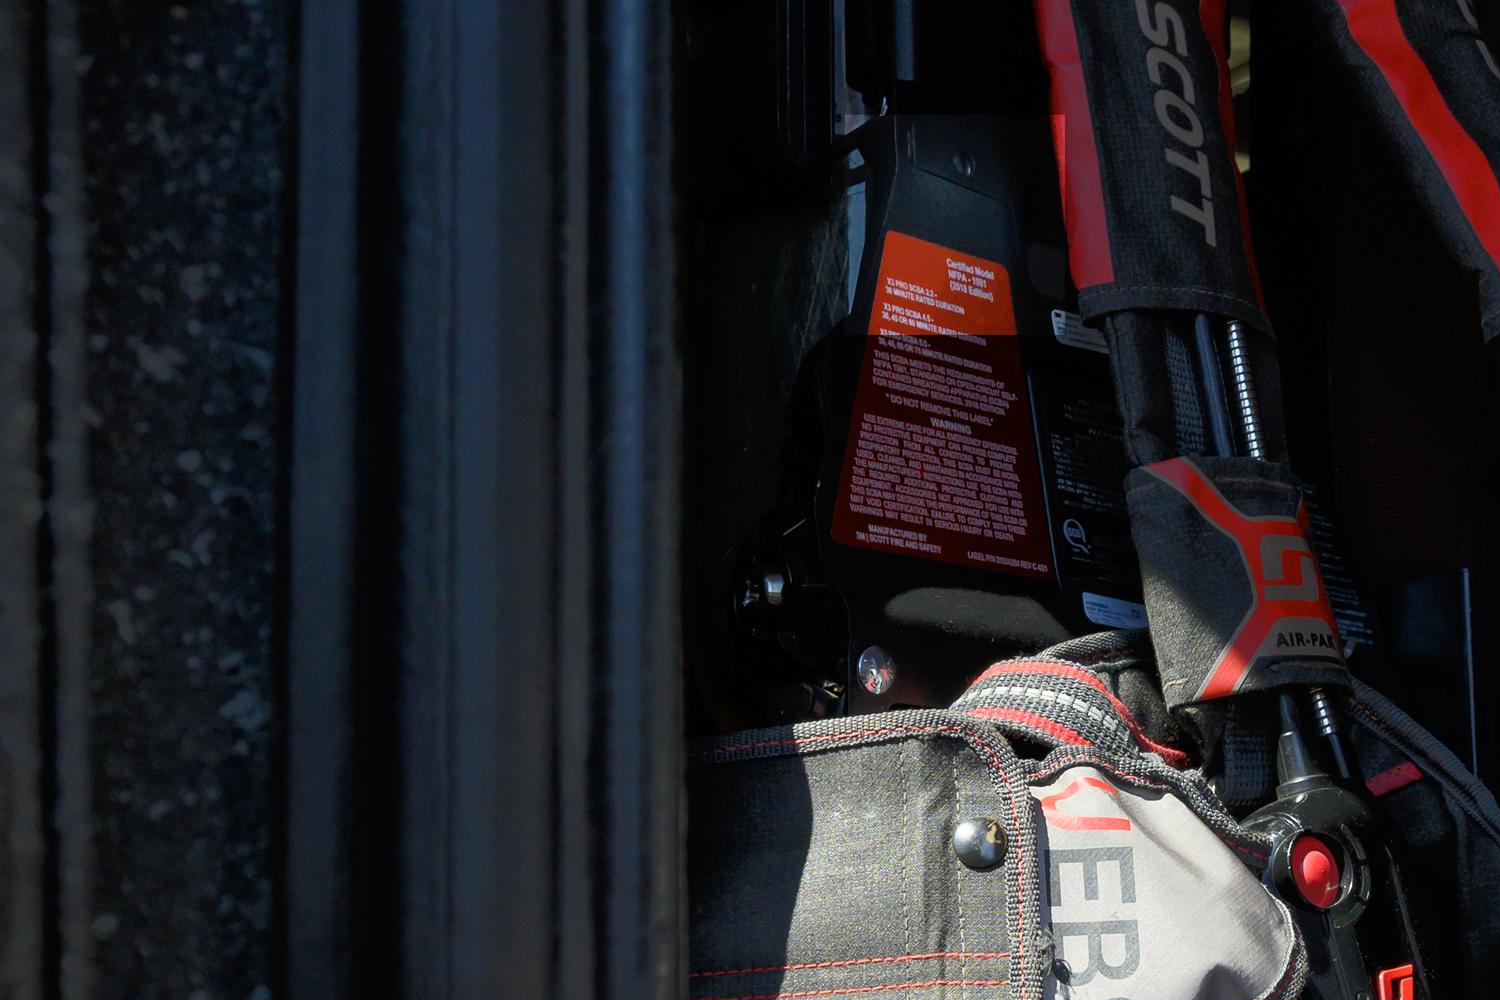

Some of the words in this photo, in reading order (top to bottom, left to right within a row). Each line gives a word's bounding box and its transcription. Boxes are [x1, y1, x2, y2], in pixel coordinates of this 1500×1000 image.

[1136, 0, 1217, 248] SCOTT
[946, 257, 974, 274] Certified
[974, 266, 994, 280] Model
[948, 268, 966, 282] NFPA
[972, 276, 986, 288] 1981
[886, 276, 894, 286] X3
[895, 279, 908, 290] PRO
[908, 283, 924, 295] SCBA
[968, 285, 993, 303] Edition)
[883, 302, 890, 311] X3
[892, 304, 904, 315] PRO
[905, 308, 920, 319] SCBA
[893, 286, 914, 301] MINUTE
[915, 293, 934, 306] RATED
[935, 299, 964, 315] DURATION
[898, 315, 907, 325] OR
[916, 319, 937, 333] MINUTE
[938, 326, 957, 339] RATED
[957, 331, 986, 347] DURATION
[873, 348, 889, 360] THIS
[890, 353, 908, 365] SCBA
[909, 357, 932, 371] MEETS
[932, 364, 945, 375] THE
[946, 367, 995, 388] REQUIREMENTS
[996, 380, 1004, 390] OF
[873, 357, 892, 370] NFPA
[910, 367, 944, 384] STANDARD
[945, 376, 955, 386] ON
[1001, 390, 1018, 402] SELF-
[872, 375, 886, 387] FOR
[887, 379, 928, 397] EMERGENCY
[872, 367, 911, 384] CONTAINED
[912, 377, 949, 393] BREATHING
[950, 386, 987, 403] APPARATUS
[988, 396, 1009, 408] (SCBA)
[890, 393, 902, 405] DO
[903, 396, 918, 408] NOT
[920, 401, 951, 416] REMOVE
[952, 408, 968, 421] THIS
[863, 412, 876, 423] USE
[877, 415, 905, 430] EXTREME
[906, 422, 922, 434] CARE
[922, 426, 935, 437] FOR
[936, 429, 945, 439] ALL
[946, 431, 981, 447] EMERGENCY
[930, 416, 971, 435] WARNING
[859, 430, 898, 446] PROTECTION
[903, 440, 920, 451] FROM
[924, 445, 935, 454] ALL
[976, 456, 984, 465] TO
[989, 459, 1013, 472] PROVIDE
[861, 421, 871, 431] NO
[873, 424, 910, 440] PROTECTIVE
[913, 433, 945, 448] EQUIPMENT
[948, 441, 960, 451] CAN
[962, 444, 986, 457] PROVIDE
[987, 450, 1016, 464] COMPLETE
[858, 439, 899, 456] RESPIRATORY
[942, 457, 956, 468] THIS
[958, 461, 973, 472] SCBA
[975, 465, 990, 475] MUST
[992, 468, 1000, 477] BE
[908, 459, 921, 469] AND
[923, 462, 957, 477] MAINTAINED
[957, 470, 964, 478] IN
[965, 471, 1003, 487] ACCORDANCE
[1003, 480, 1017, 490] WITH
[868, 523, 917, 540] MANUFACTURED
[918, 532, 927, 542] BY
[869, 532, 888, 544] SCOTT
[890, 536, 904, 547] FIRE
[904, 539, 918, 549] AND
[918, 541, 941, 553] SAFETY
[1277, 632, 1336, 649] AIR-PAK
